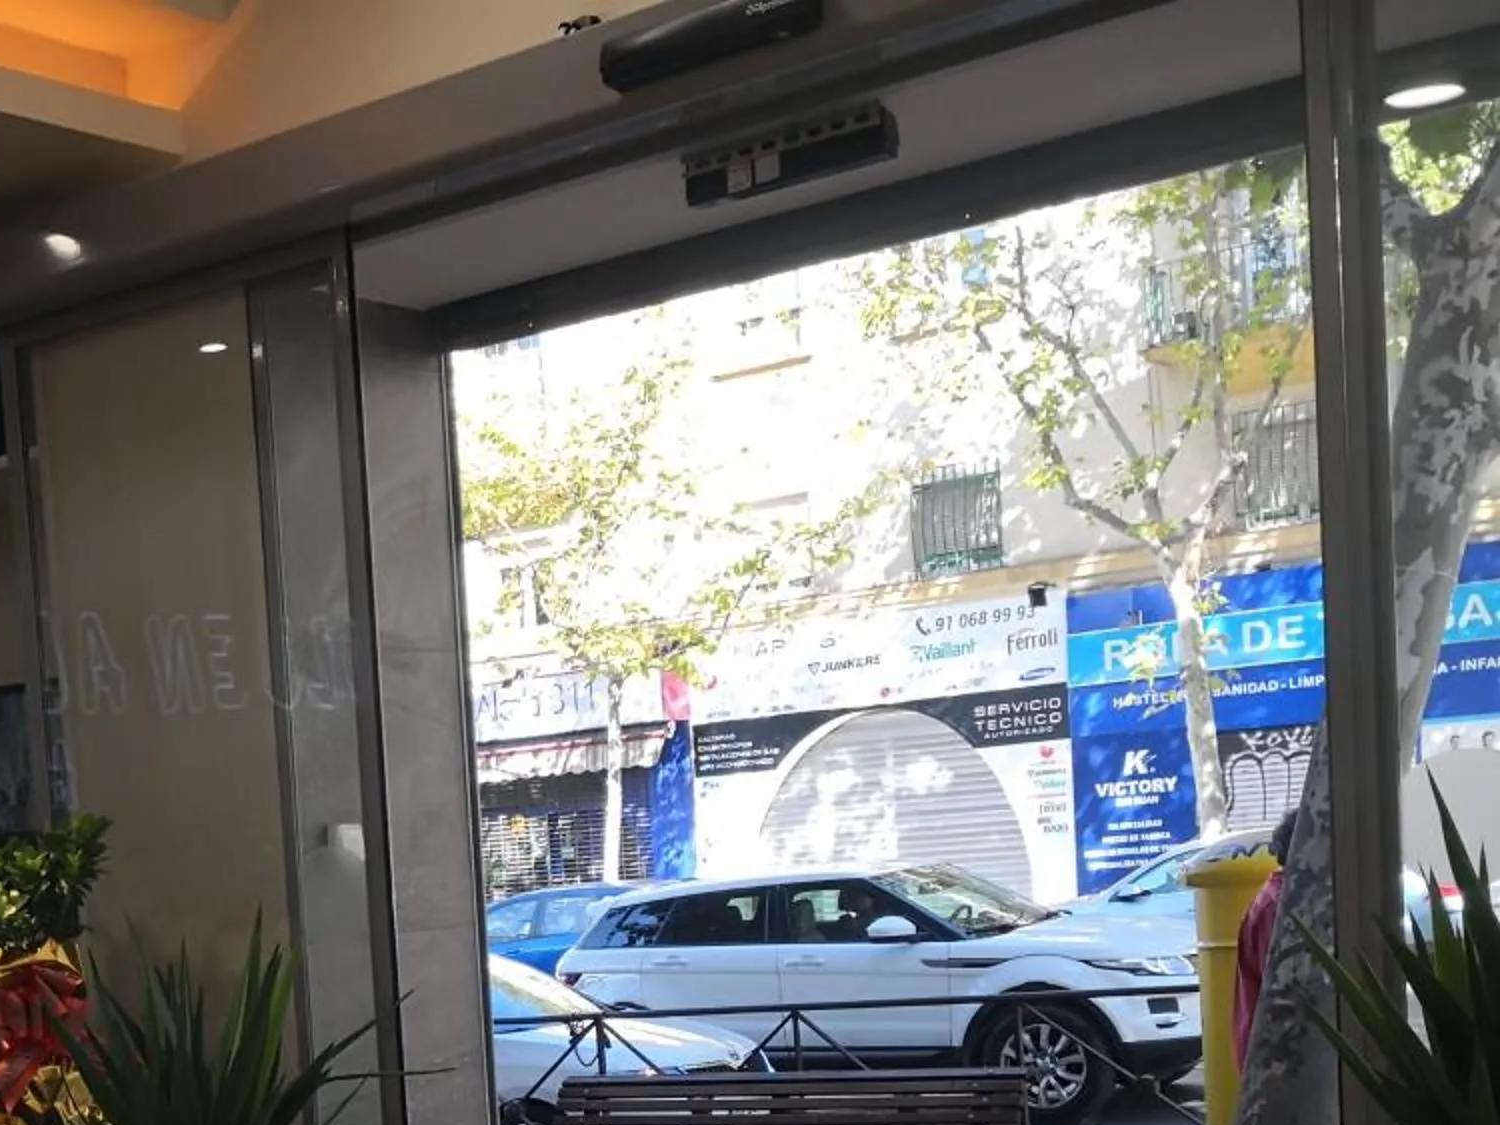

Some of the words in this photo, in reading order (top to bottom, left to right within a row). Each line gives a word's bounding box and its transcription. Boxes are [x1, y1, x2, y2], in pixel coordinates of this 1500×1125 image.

[934, 615, 953, 632] 91
[959, 610, 988, 629] 068
[992, 607, 1011, 624] 99
[1016, 604, 1035, 620] 93
[1241, 615, 1306, 655] DE
[922, 639, 977, 661] Vaillant
[1288, 675, 1325, 690] LIMP
[973, 697, 1062, 718] SERVICIO
[973, 711, 1062, 732] TECNICO
[1094, 776, 1178, 798] VICTORY
